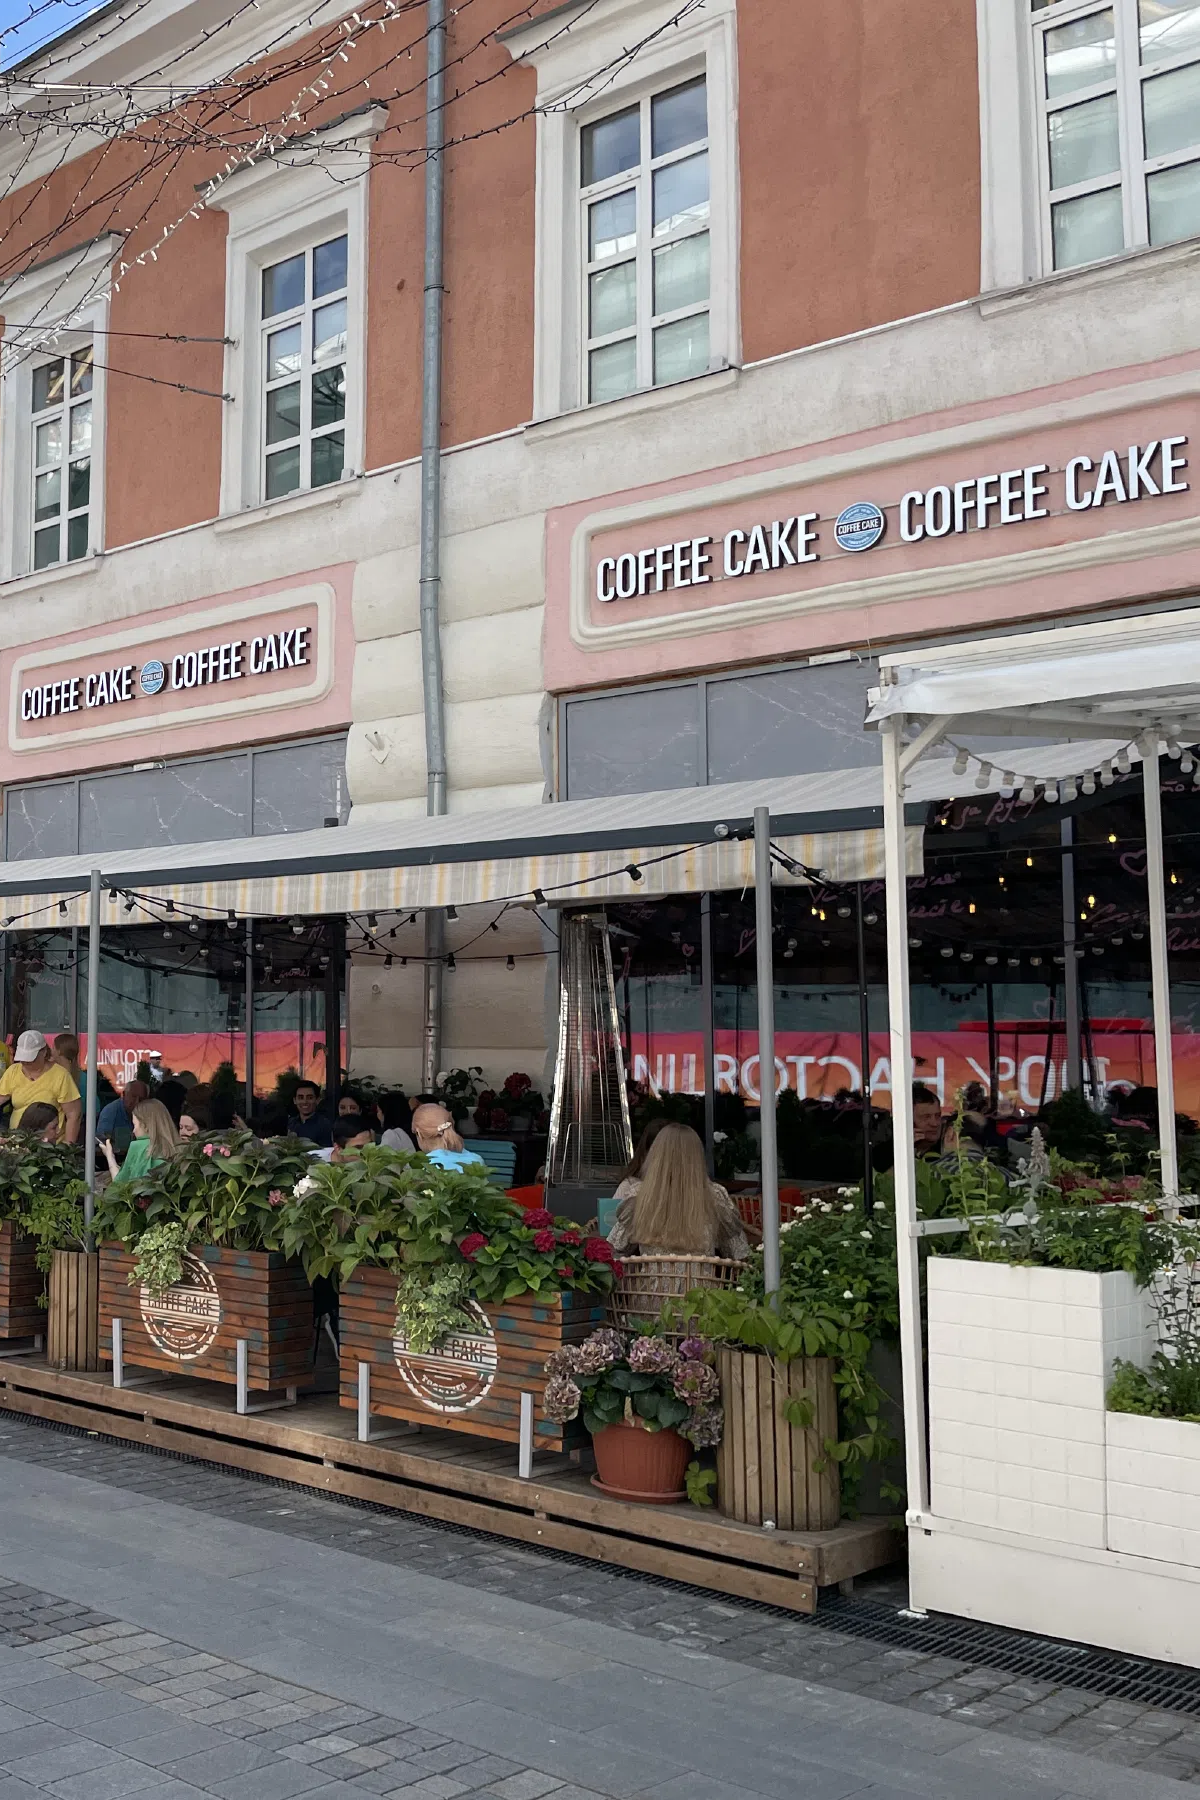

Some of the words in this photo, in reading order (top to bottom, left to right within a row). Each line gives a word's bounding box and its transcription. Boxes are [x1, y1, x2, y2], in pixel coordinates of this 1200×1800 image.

[899, 463, 1049, 542] COFFEE
[1065, 436, 1189, 511] CAKE
[596, 535, 711, 602] COFFEE
[723, 512, 819, 578] CAKE
[838, 521, 861, 535] COFFEE
[861, 518, 879, 530] CAKE
[171, 640, 245, 691] COFFEE
[250, 626, 311, 674] CAKE
[21, 676, 81, 722] COFFEE
[85, 664, 135, 707] CAKE
[452, 1338, 487, 1363] CAKE
